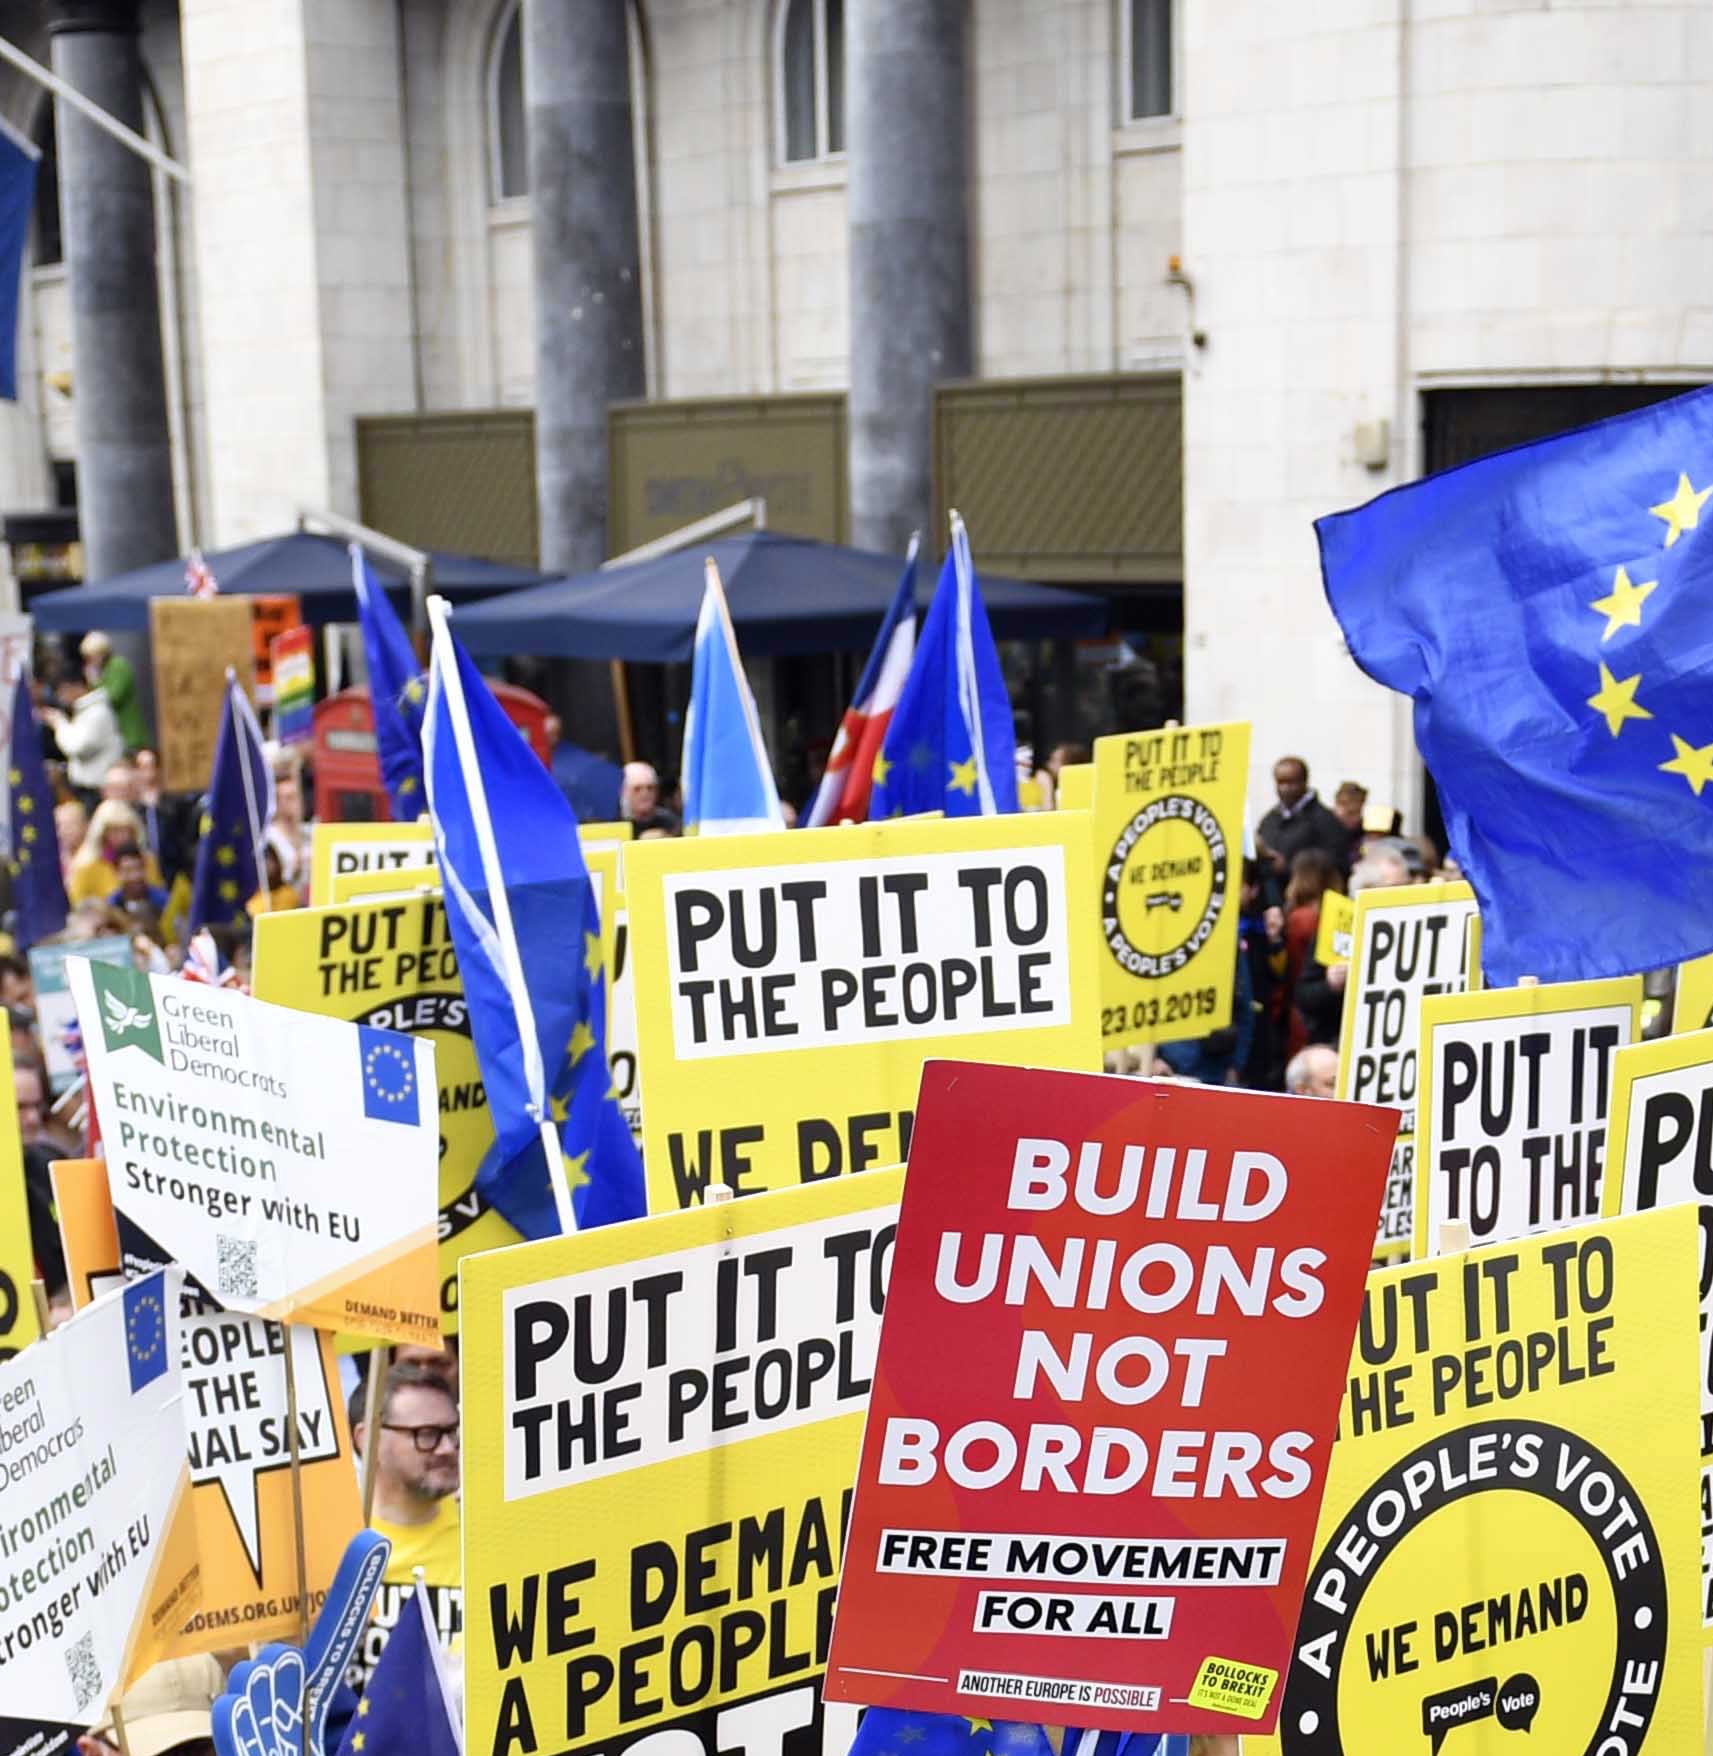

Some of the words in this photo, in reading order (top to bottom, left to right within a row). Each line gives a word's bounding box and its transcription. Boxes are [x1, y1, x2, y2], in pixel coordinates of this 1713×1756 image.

[1124, 739, 1165, 769] PUT
[1170, 735, 1190, 761] IT
[1198, 730, 1222, 760] TO
[1124, 769, 1155, 793] THE
[1160, 761, 1220, 791] PEOPLE
[675, 878, 829, 974] PUT
[858, 871, 931, 959] IT
[958, 862, 1051, 950] TO
[161, 994, 236, 1031] Green
[679, 969, 801, 1045] THE
[822, 950, 1055, 1032] PEOPLE
[1101, 986, 1217, 1038] 23.03.2019
[166, 1024, 242, 1061] Liberal
[169, 1053, 289, 1102] Democrats
[112, 1080, 326, 1162] Environmental
[118, 1120, 278, 1184] Protection
[1006, 1136, 1289, 1225] BUILD
[123, 1160, 252, 1220] Stronger
[258, 1193, 320, 1235] with
[327, 1209, 361, 1246] EU
[933, 1230, 1329, 1320] UNIONS
[1463, 1252, 1521, 1343] IT
[1541, 1232, 1617, 1313] TO
[1012, 1329, 1229, 1409] NOT
[1432, 1314, 1618, 1413] PEOPLE
[877, 1415, 1316, 1501] BORDERS
[881, 1533, 994, 1573] FREE
[1004, 1538, 1283, 1581] MOVEMENT
[980, 1595, 1076, 1633] FOR
[1085, 1599, 1167, 1636] ALL
[1365, 1620, 1421, 1684] WE
[1433, 1571, 1590, 1660] DEMAND
[960, 1675, 1023, 1696] ANOTHER
[1025, 1682, 1077, 1700] EUROPE
[1078, 1686, 1092, 1701] IS
[1094, 1687, 1156, 1708] POSSIBLE
[1201, 1674, 1218, 1687] TO
[1220, 1678, 1267, 1698] BREXIT
[1206, 1663, 1269, 1685] BOLLOCKS
[1429, 1686, 1493, 1724] People's
[1500, 1685, 1538, 1714] Vote
